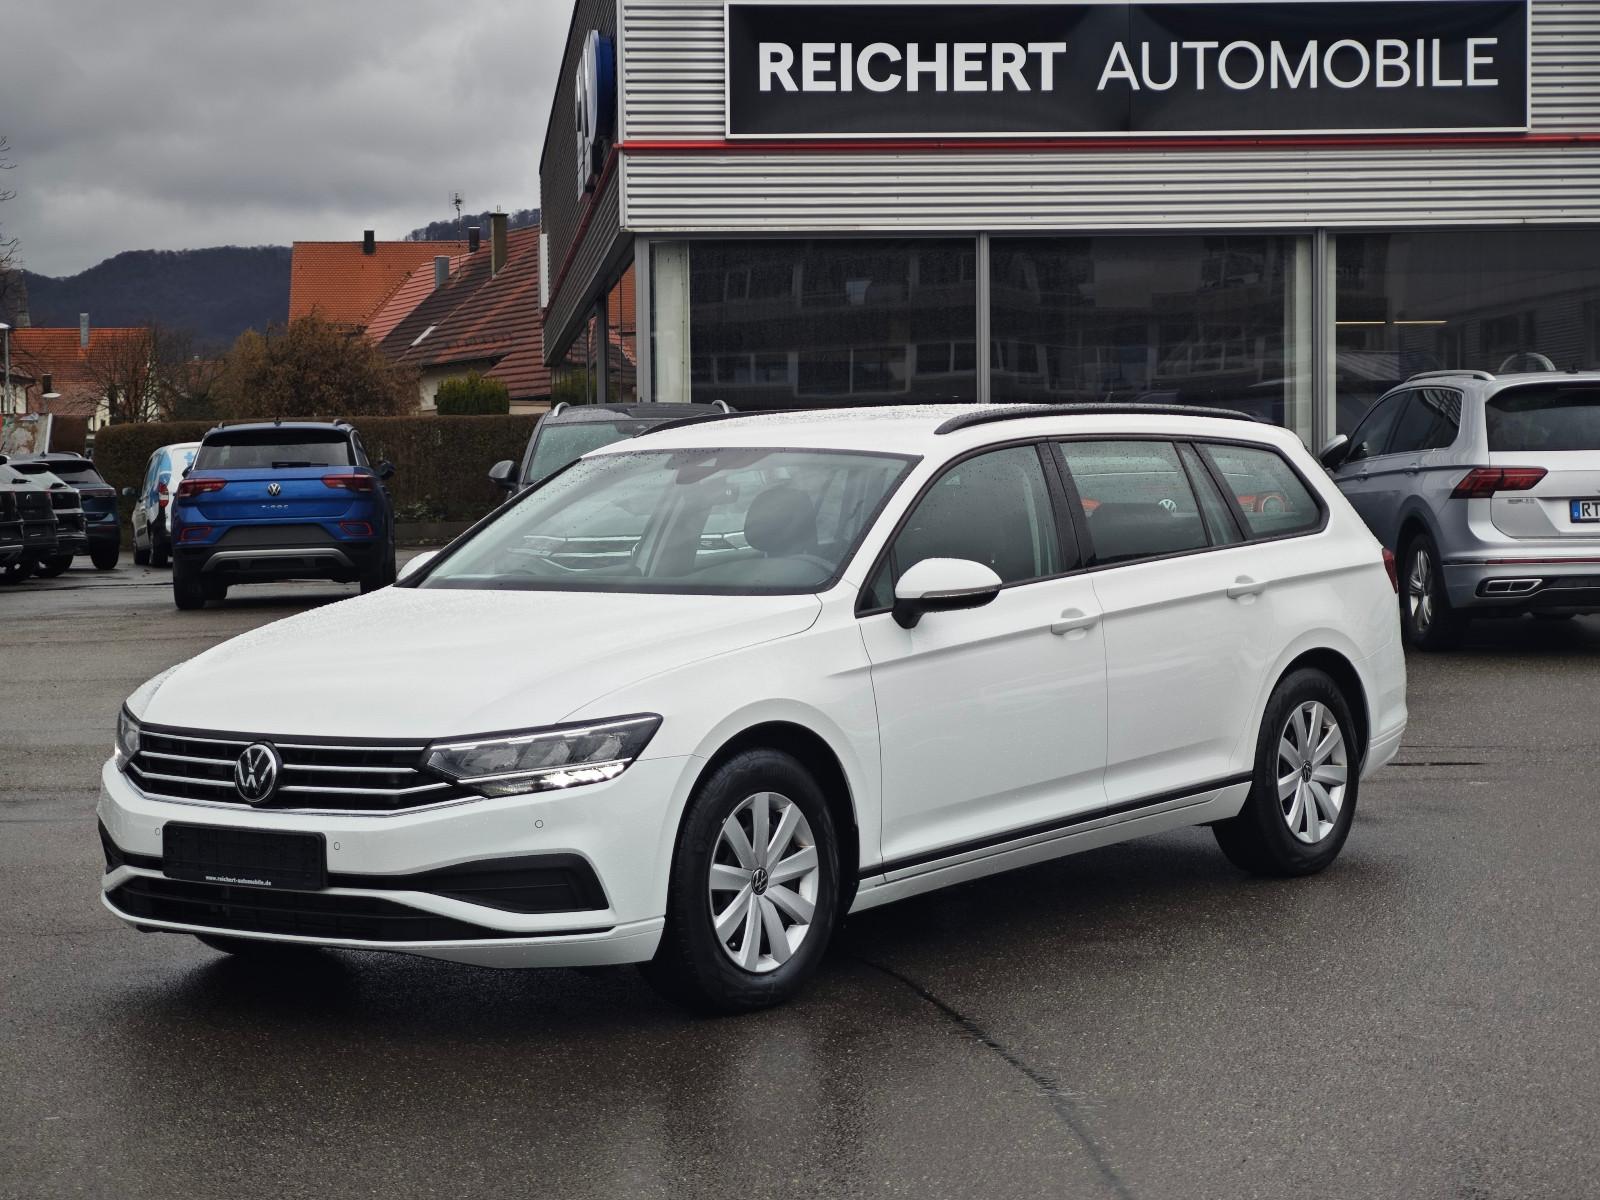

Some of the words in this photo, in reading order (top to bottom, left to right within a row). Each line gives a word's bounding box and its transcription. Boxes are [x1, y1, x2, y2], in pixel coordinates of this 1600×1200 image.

[758, 41, 1066, 92] REICHERT
[1096, 37, 1499, 91] AUTOMOBILE
[1581, 502, 1600, 517] RT
[205, 875, 271, 886] www.reichert-automobile.de
